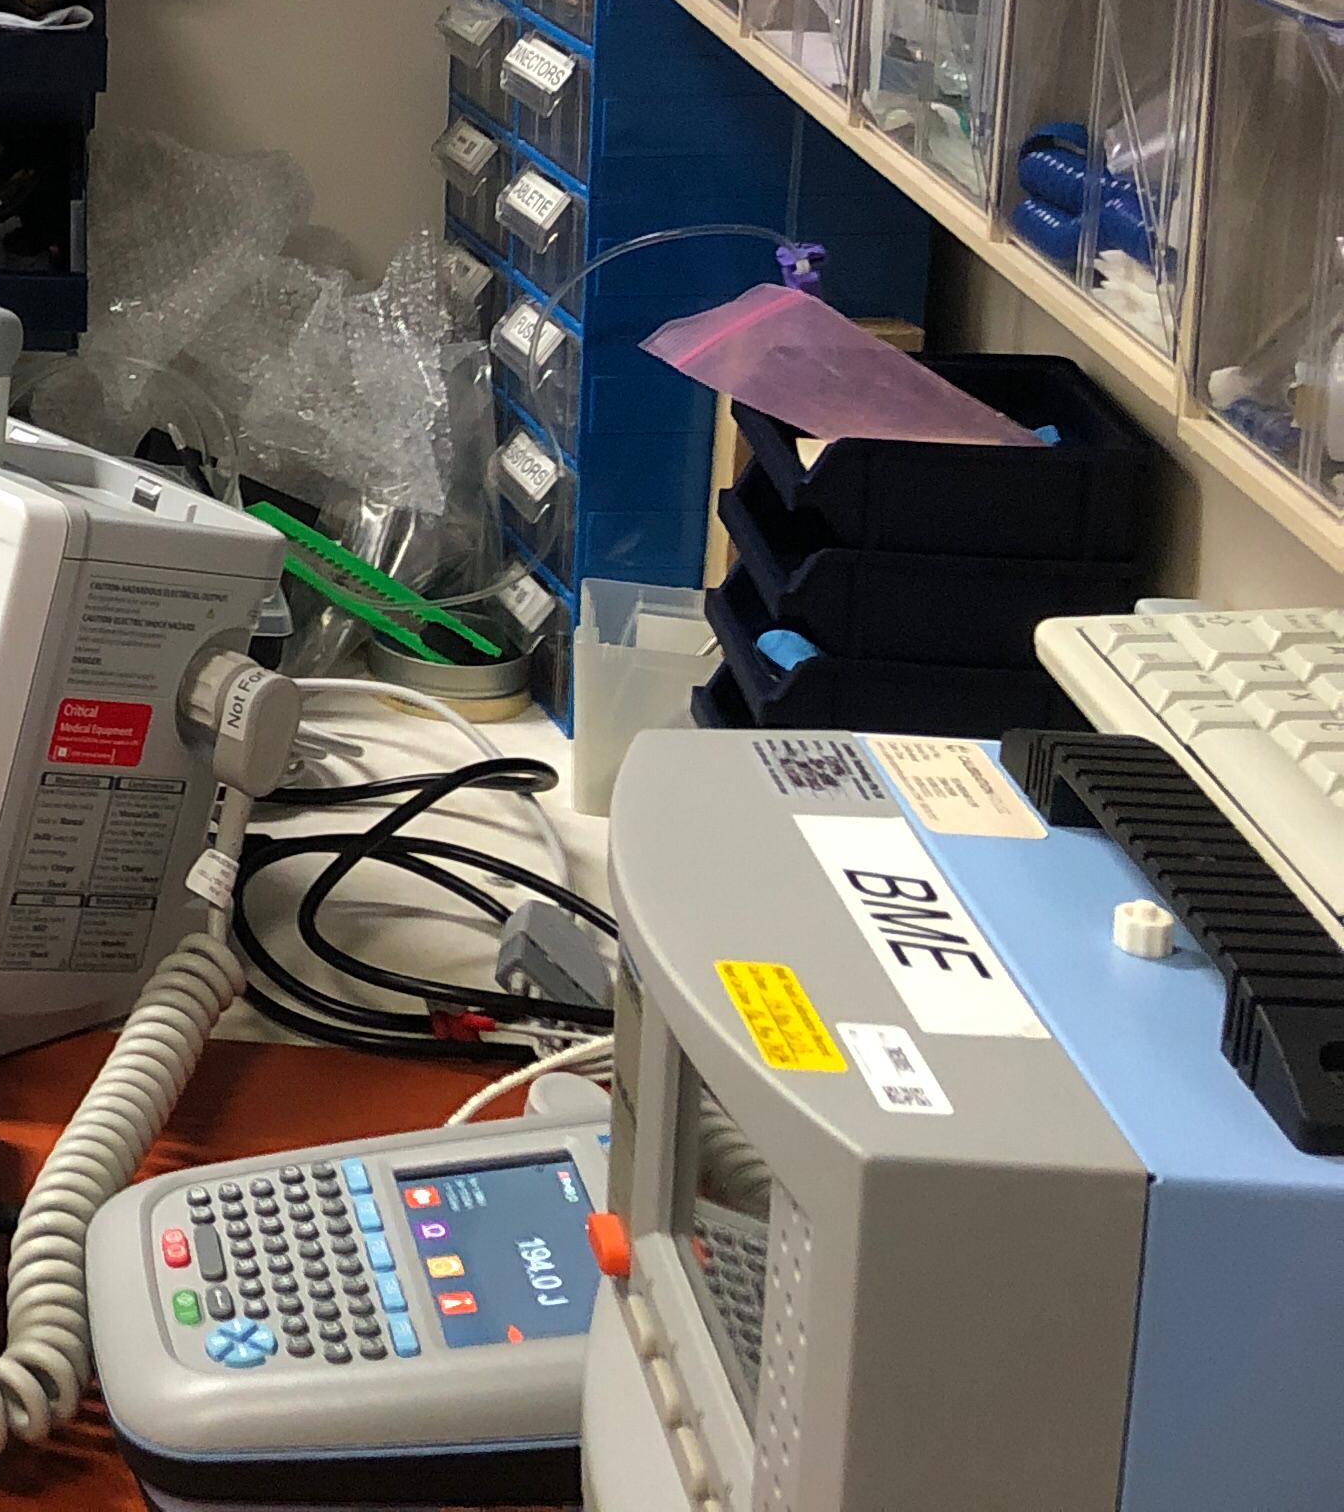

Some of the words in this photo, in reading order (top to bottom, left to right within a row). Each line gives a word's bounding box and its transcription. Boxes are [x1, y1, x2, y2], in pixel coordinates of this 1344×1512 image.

[63, 703, 99, 718] Critical
[226, 694, 246, 729] Not
[60, 722, 90, 735] Medical
[91, 724, 133, 738] Equipment
[842, 867, 993, 981] BME
[515, 1236, 564, 1291] 194.0
